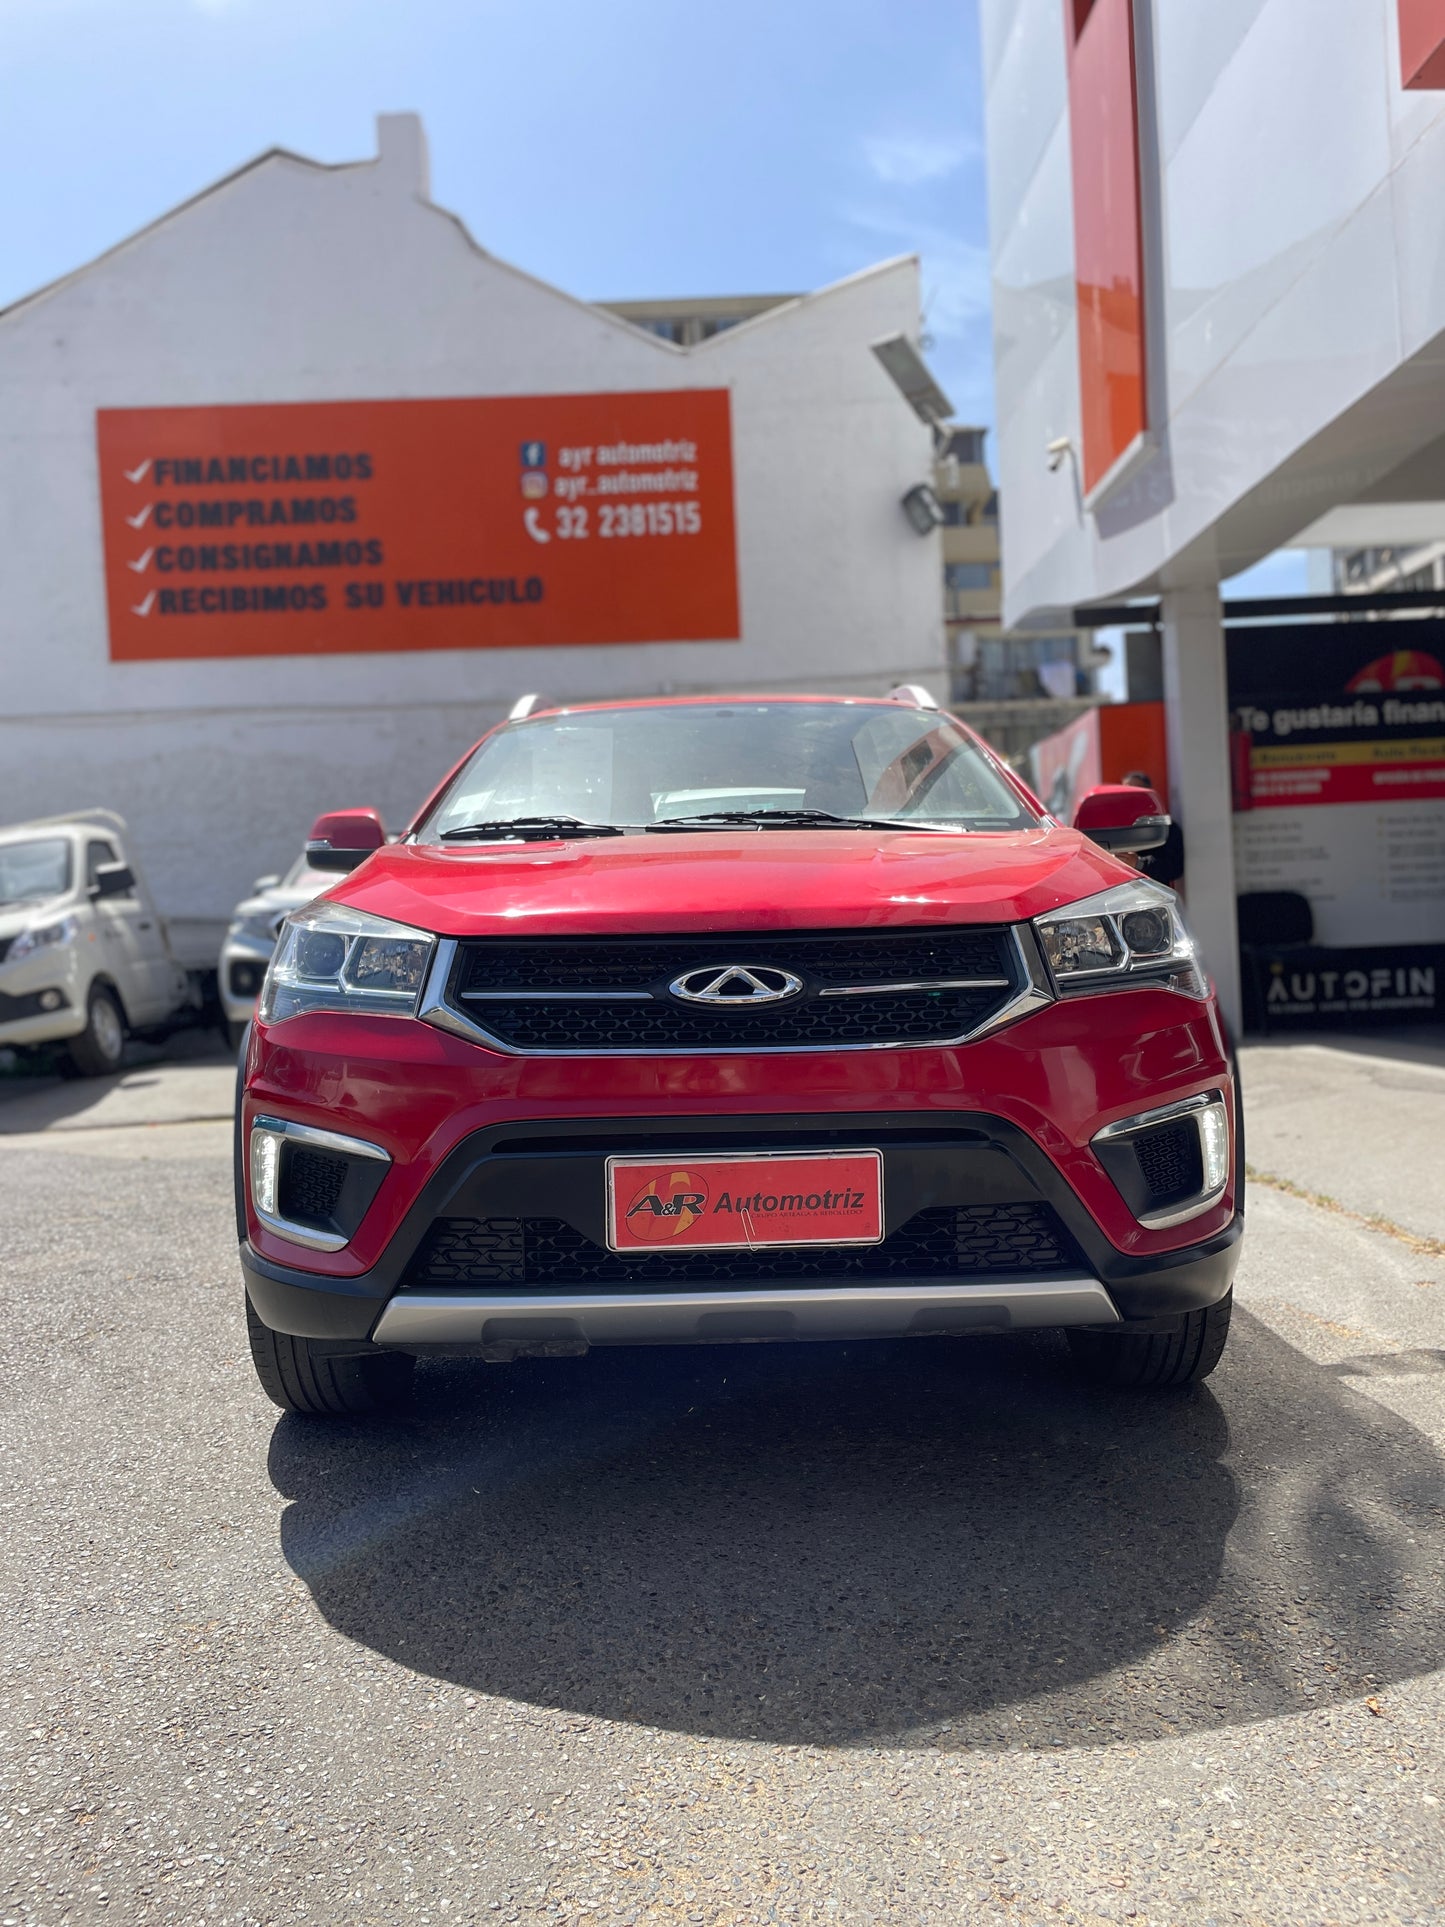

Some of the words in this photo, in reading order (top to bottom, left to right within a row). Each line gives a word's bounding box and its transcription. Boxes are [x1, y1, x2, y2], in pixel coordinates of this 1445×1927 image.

[154, 453, 374, 486] FINANCIAMOS
[558, 446, 593, 472] ayr
[596, 439, 698, 466] automotriz
[154, 496, 358, 529] COMPRAMOS
[556, 505, 589, 539] 32
[155, 539, 384, 573] CONSIGNAMOS
[159, 584, 328, 616] RECIBIMOS
[345, 582, 386, 609] SU
[396, 575, 544, 607] VEHICULO
[1238, 705, 1270, 732] Te
[1273, 700, 1379, 736] gustaría
[1267, 964, 1436, 1002] AUTOFIN
[626, 1192, 706, 1217] A&R
[713, 1188, 865, 1213] Automotriz
